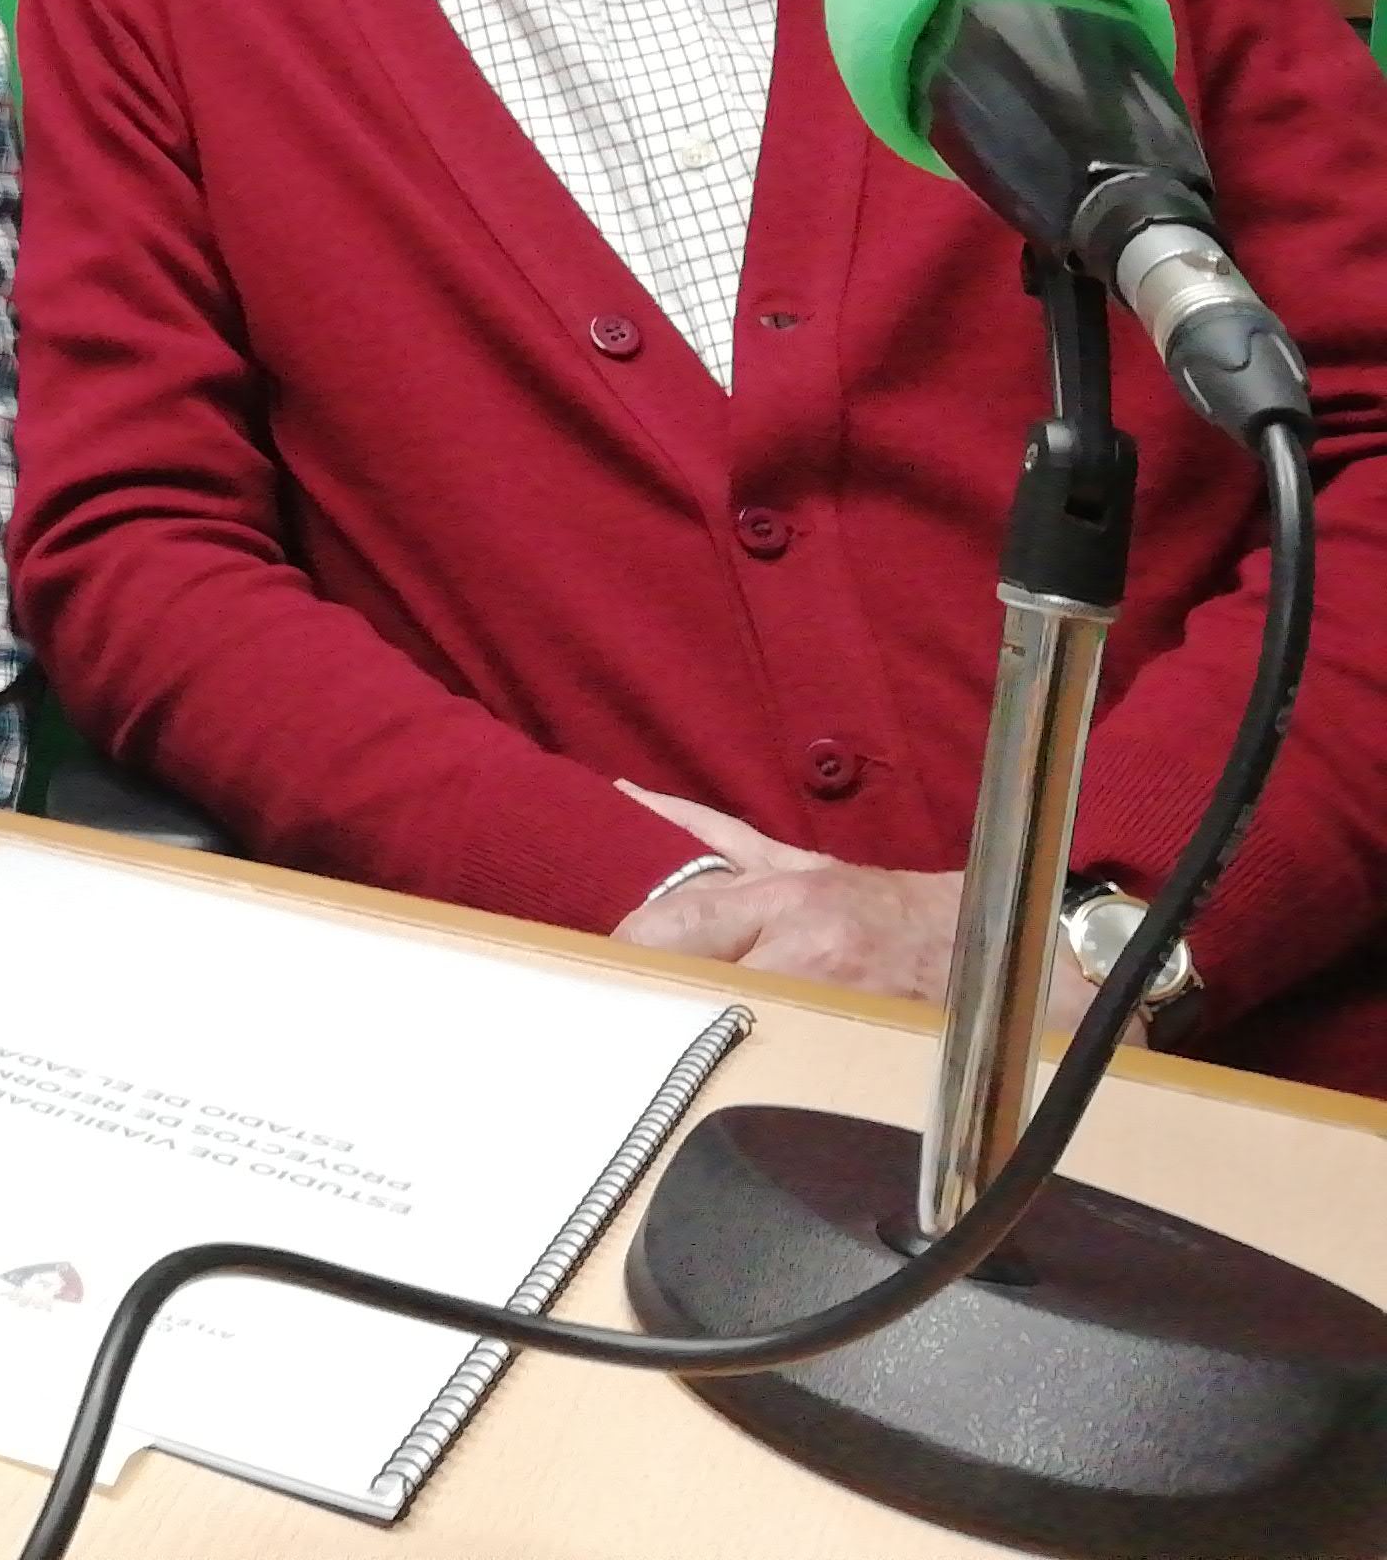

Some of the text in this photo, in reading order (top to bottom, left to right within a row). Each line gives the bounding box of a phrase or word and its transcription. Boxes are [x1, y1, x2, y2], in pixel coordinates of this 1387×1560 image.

[98, 1076, 134, 1092] EL
[141, 1089, 191, 1108] DE
[133, 1108, 183, 1128] DE
[199, 1105, 354, 1153] ESTADIO
[187, 1146, 239, 1166] DE
[191, 1124, 412, 1191] PROYECTOS
[249, 1163, 412, 1216] ESTUDIO
